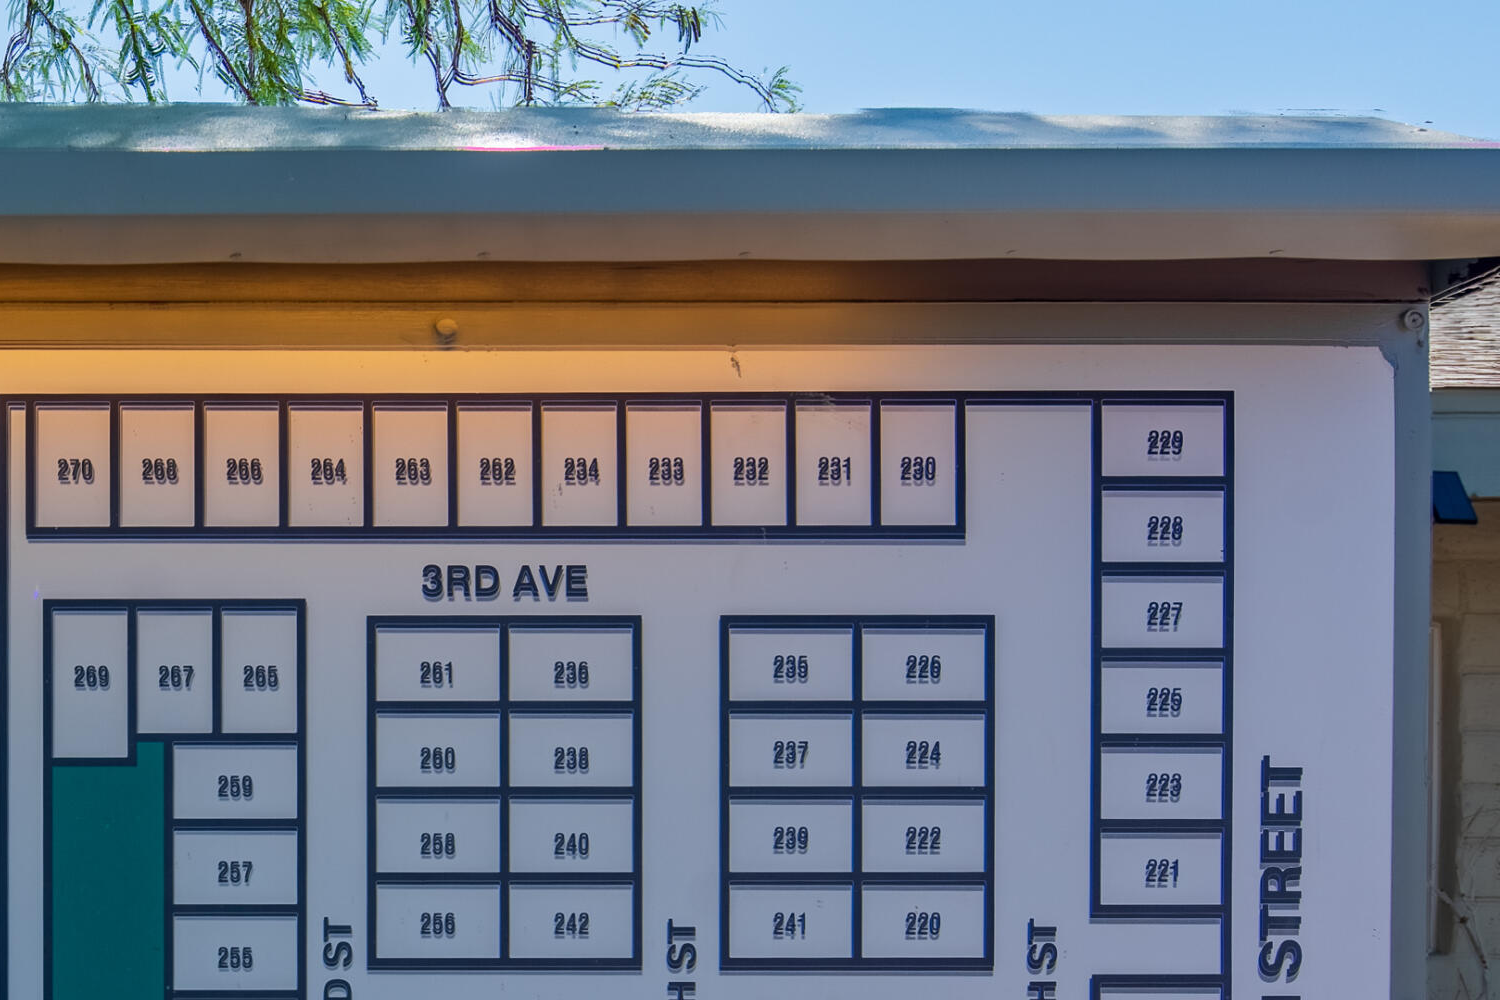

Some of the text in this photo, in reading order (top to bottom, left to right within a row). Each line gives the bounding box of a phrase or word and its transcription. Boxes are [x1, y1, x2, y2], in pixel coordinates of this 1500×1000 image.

[57, 458, 95, 485] 270
[141, 458, 179, 485] 268
[226, 457, 264, 485] 266
[310, 457, 348, 486] 264
[395, 457, 432, 486] 263
[479, 457, 516, 486] 262
[564, 457, 601, 486] 234
[648, 456, 685, 486] 233
[733, 456, 769, 486] 232
[817, 456, 851, 486] 231
[900, 456, 937, 486] 230
[421, 564, 589, 603] 3RD AVE
[1146, 601, 1183, 632] 227
[74, 665, 110, 688] 269
[158, 665, 195, 690] 267
[243, 664, 279, 692] 265
[419, 661, 453, 689] 261
[553, 660, 589, 689] 236
[773, 654, 809, 684] 235
[905, 654, 942, 684] 226
[420, 746, 456, 774] 260
[553, 746, 589, 774] 238
[773, 740, 809, 769] 237
[905, 740, 942, 770] 224
[217, 774, 253, 801] 259
[420, 832, 456, 858] 258
[553, 832, 590, 860] 240
[772, 826, 809, 855] 239
[217, 860, 253, 884] 257
[1145, 858, 1179, 888] 221
[1257, 754, 1304, 983] STREET
[420, 912, 456, 939] 256
[554, 912, 590, 939] 242
[772, 911, 806, 940] 241
[905, 911, 941, 940] 220
[322, 916, 353, 968] ST
[666, 918, 697, 974] ST
[1026, 917, 1058, 975] ST
[217, 946, 253, 969] 255
